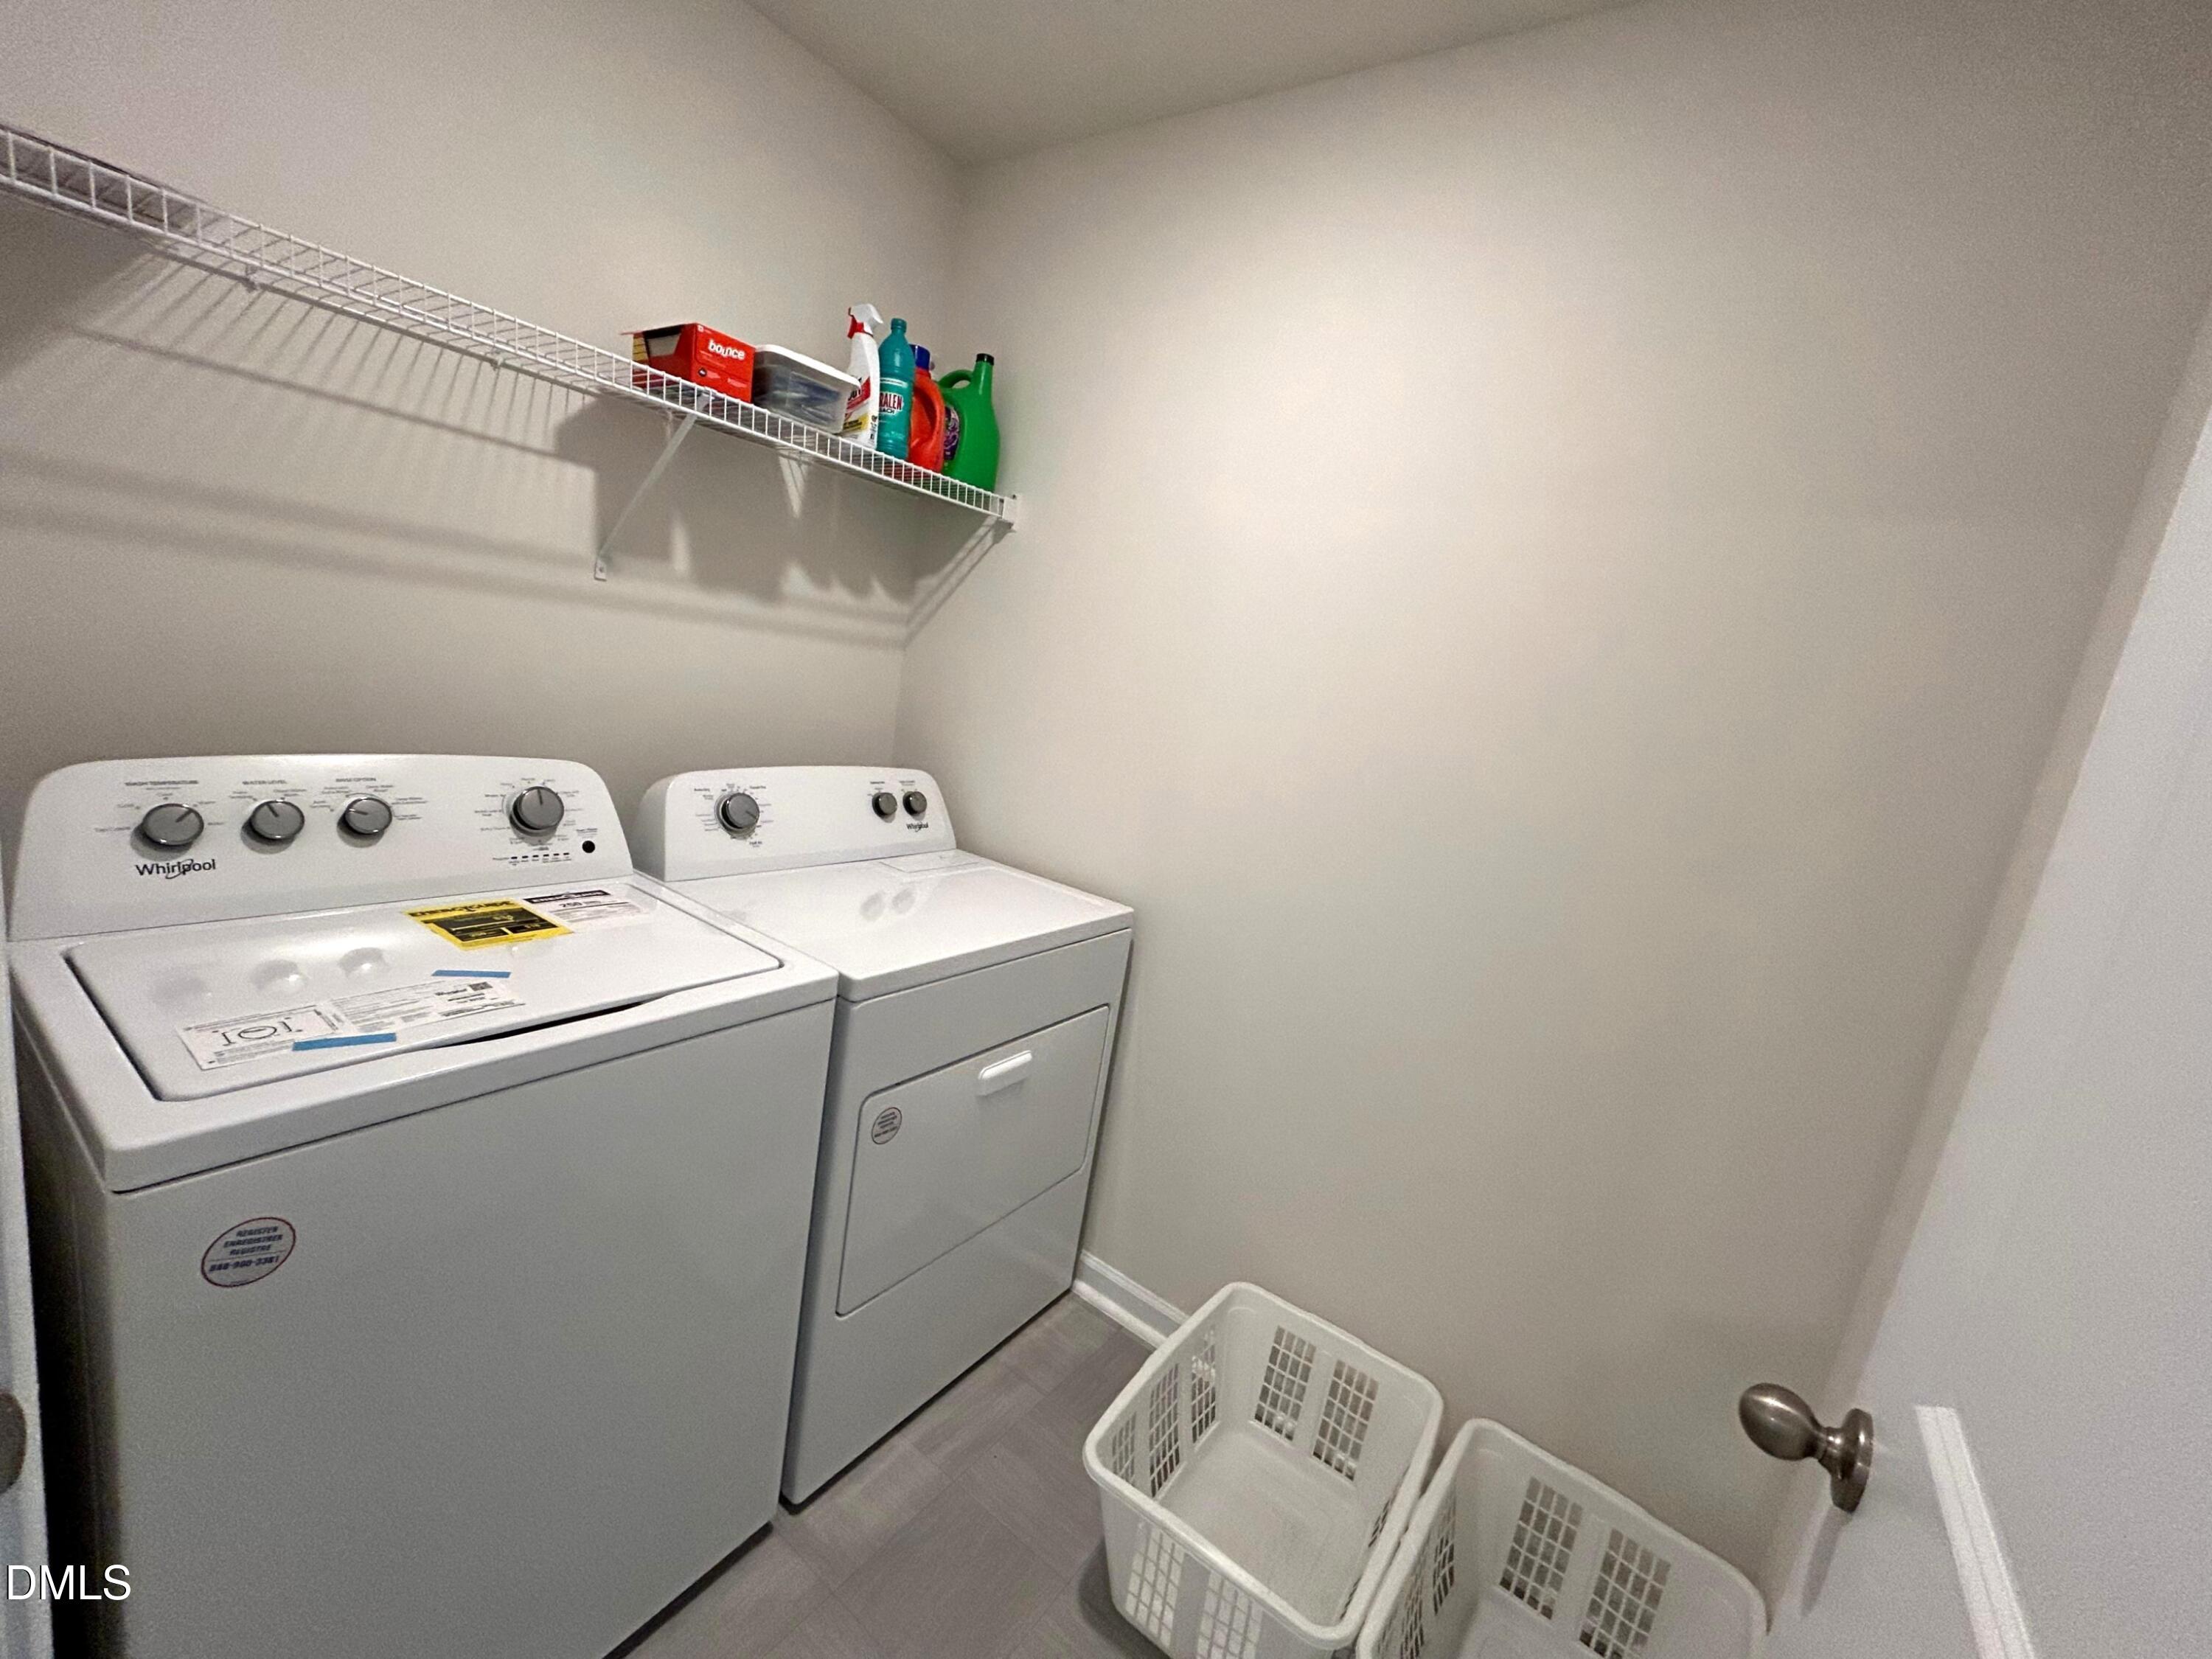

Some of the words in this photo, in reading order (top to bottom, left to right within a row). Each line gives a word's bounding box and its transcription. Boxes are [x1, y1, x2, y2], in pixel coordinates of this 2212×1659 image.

[708, 338, 745, 360] bounce
[879, 392, 902, 410] RALEN
[135, 859, 216, 879] Whirlpool
